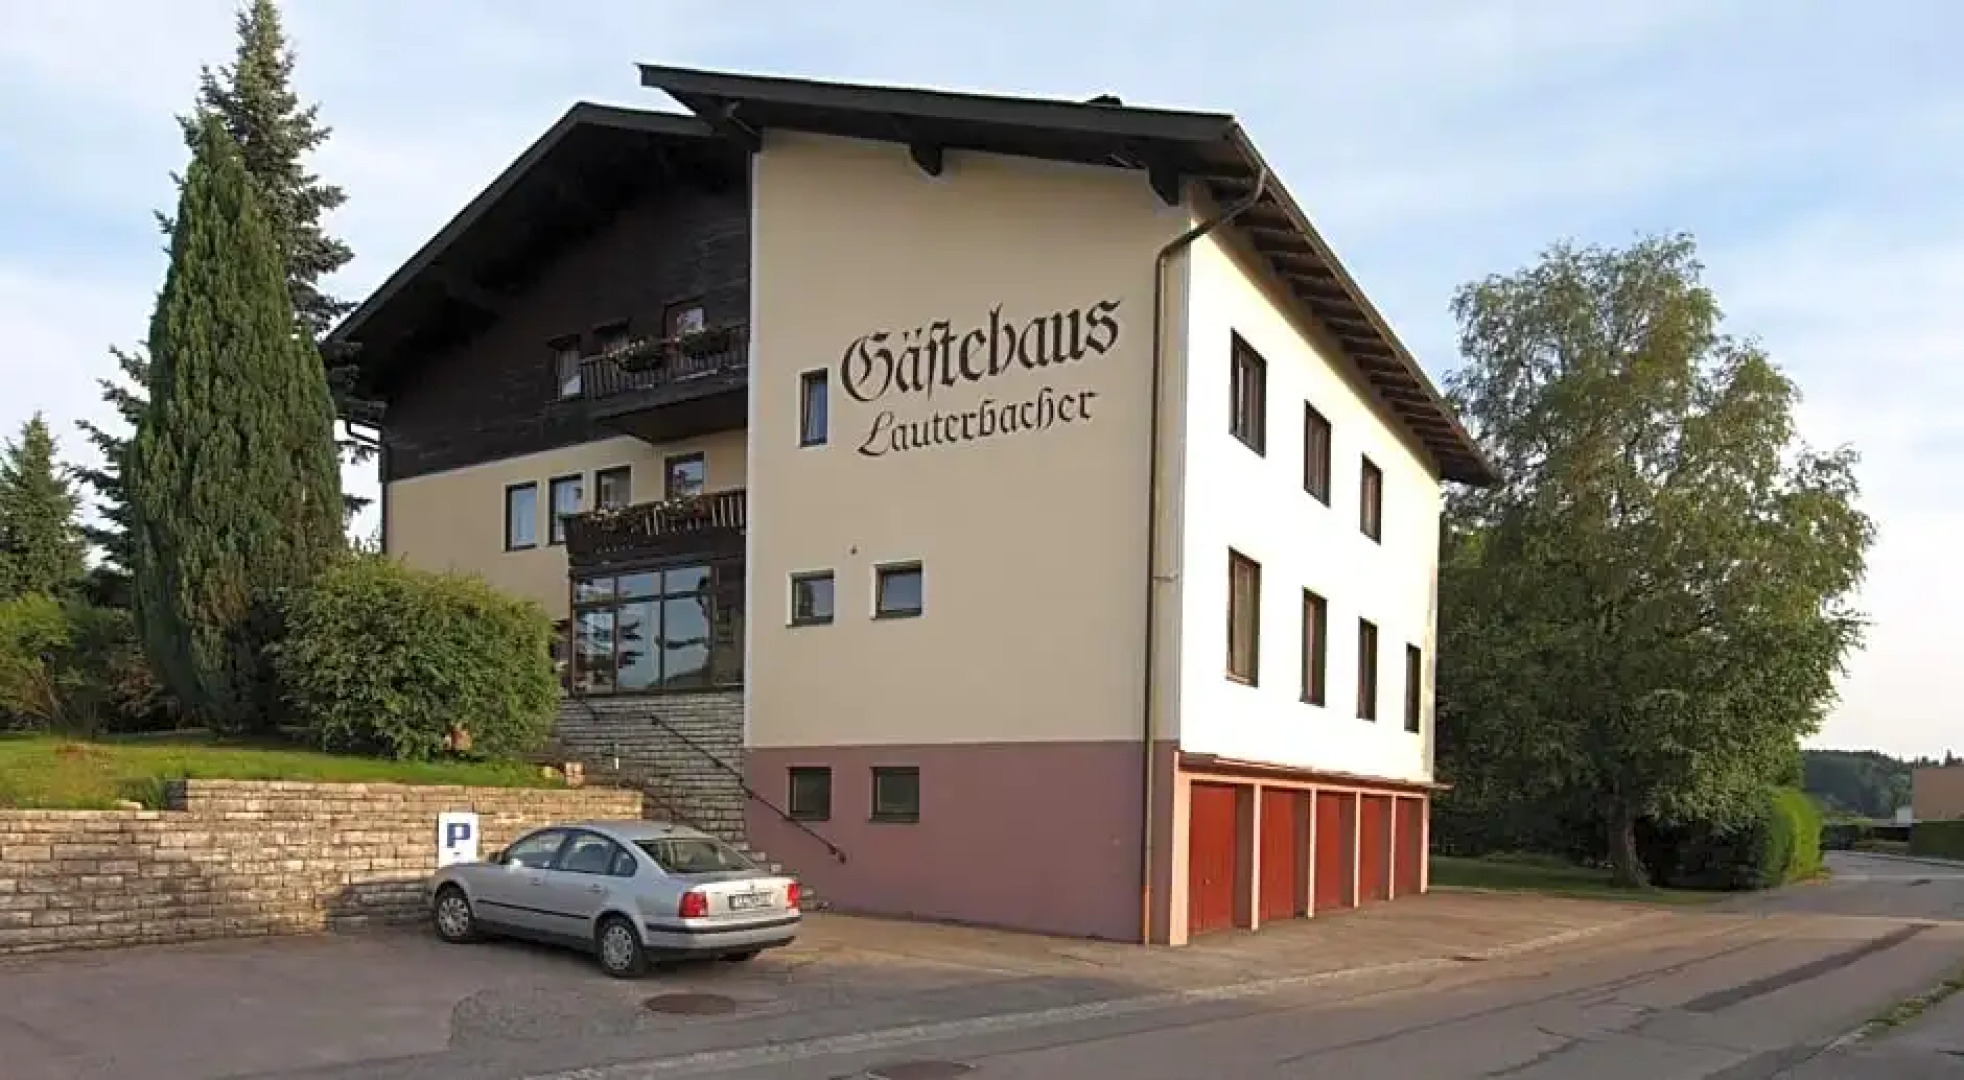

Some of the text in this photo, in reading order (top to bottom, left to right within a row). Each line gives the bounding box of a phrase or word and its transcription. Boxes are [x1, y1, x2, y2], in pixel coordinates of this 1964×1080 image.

[841, 298, 1122, 401] Gästehaus
[857, 387, 1099, 456] Lauterbacher
[446, 822, 471, 849] P
